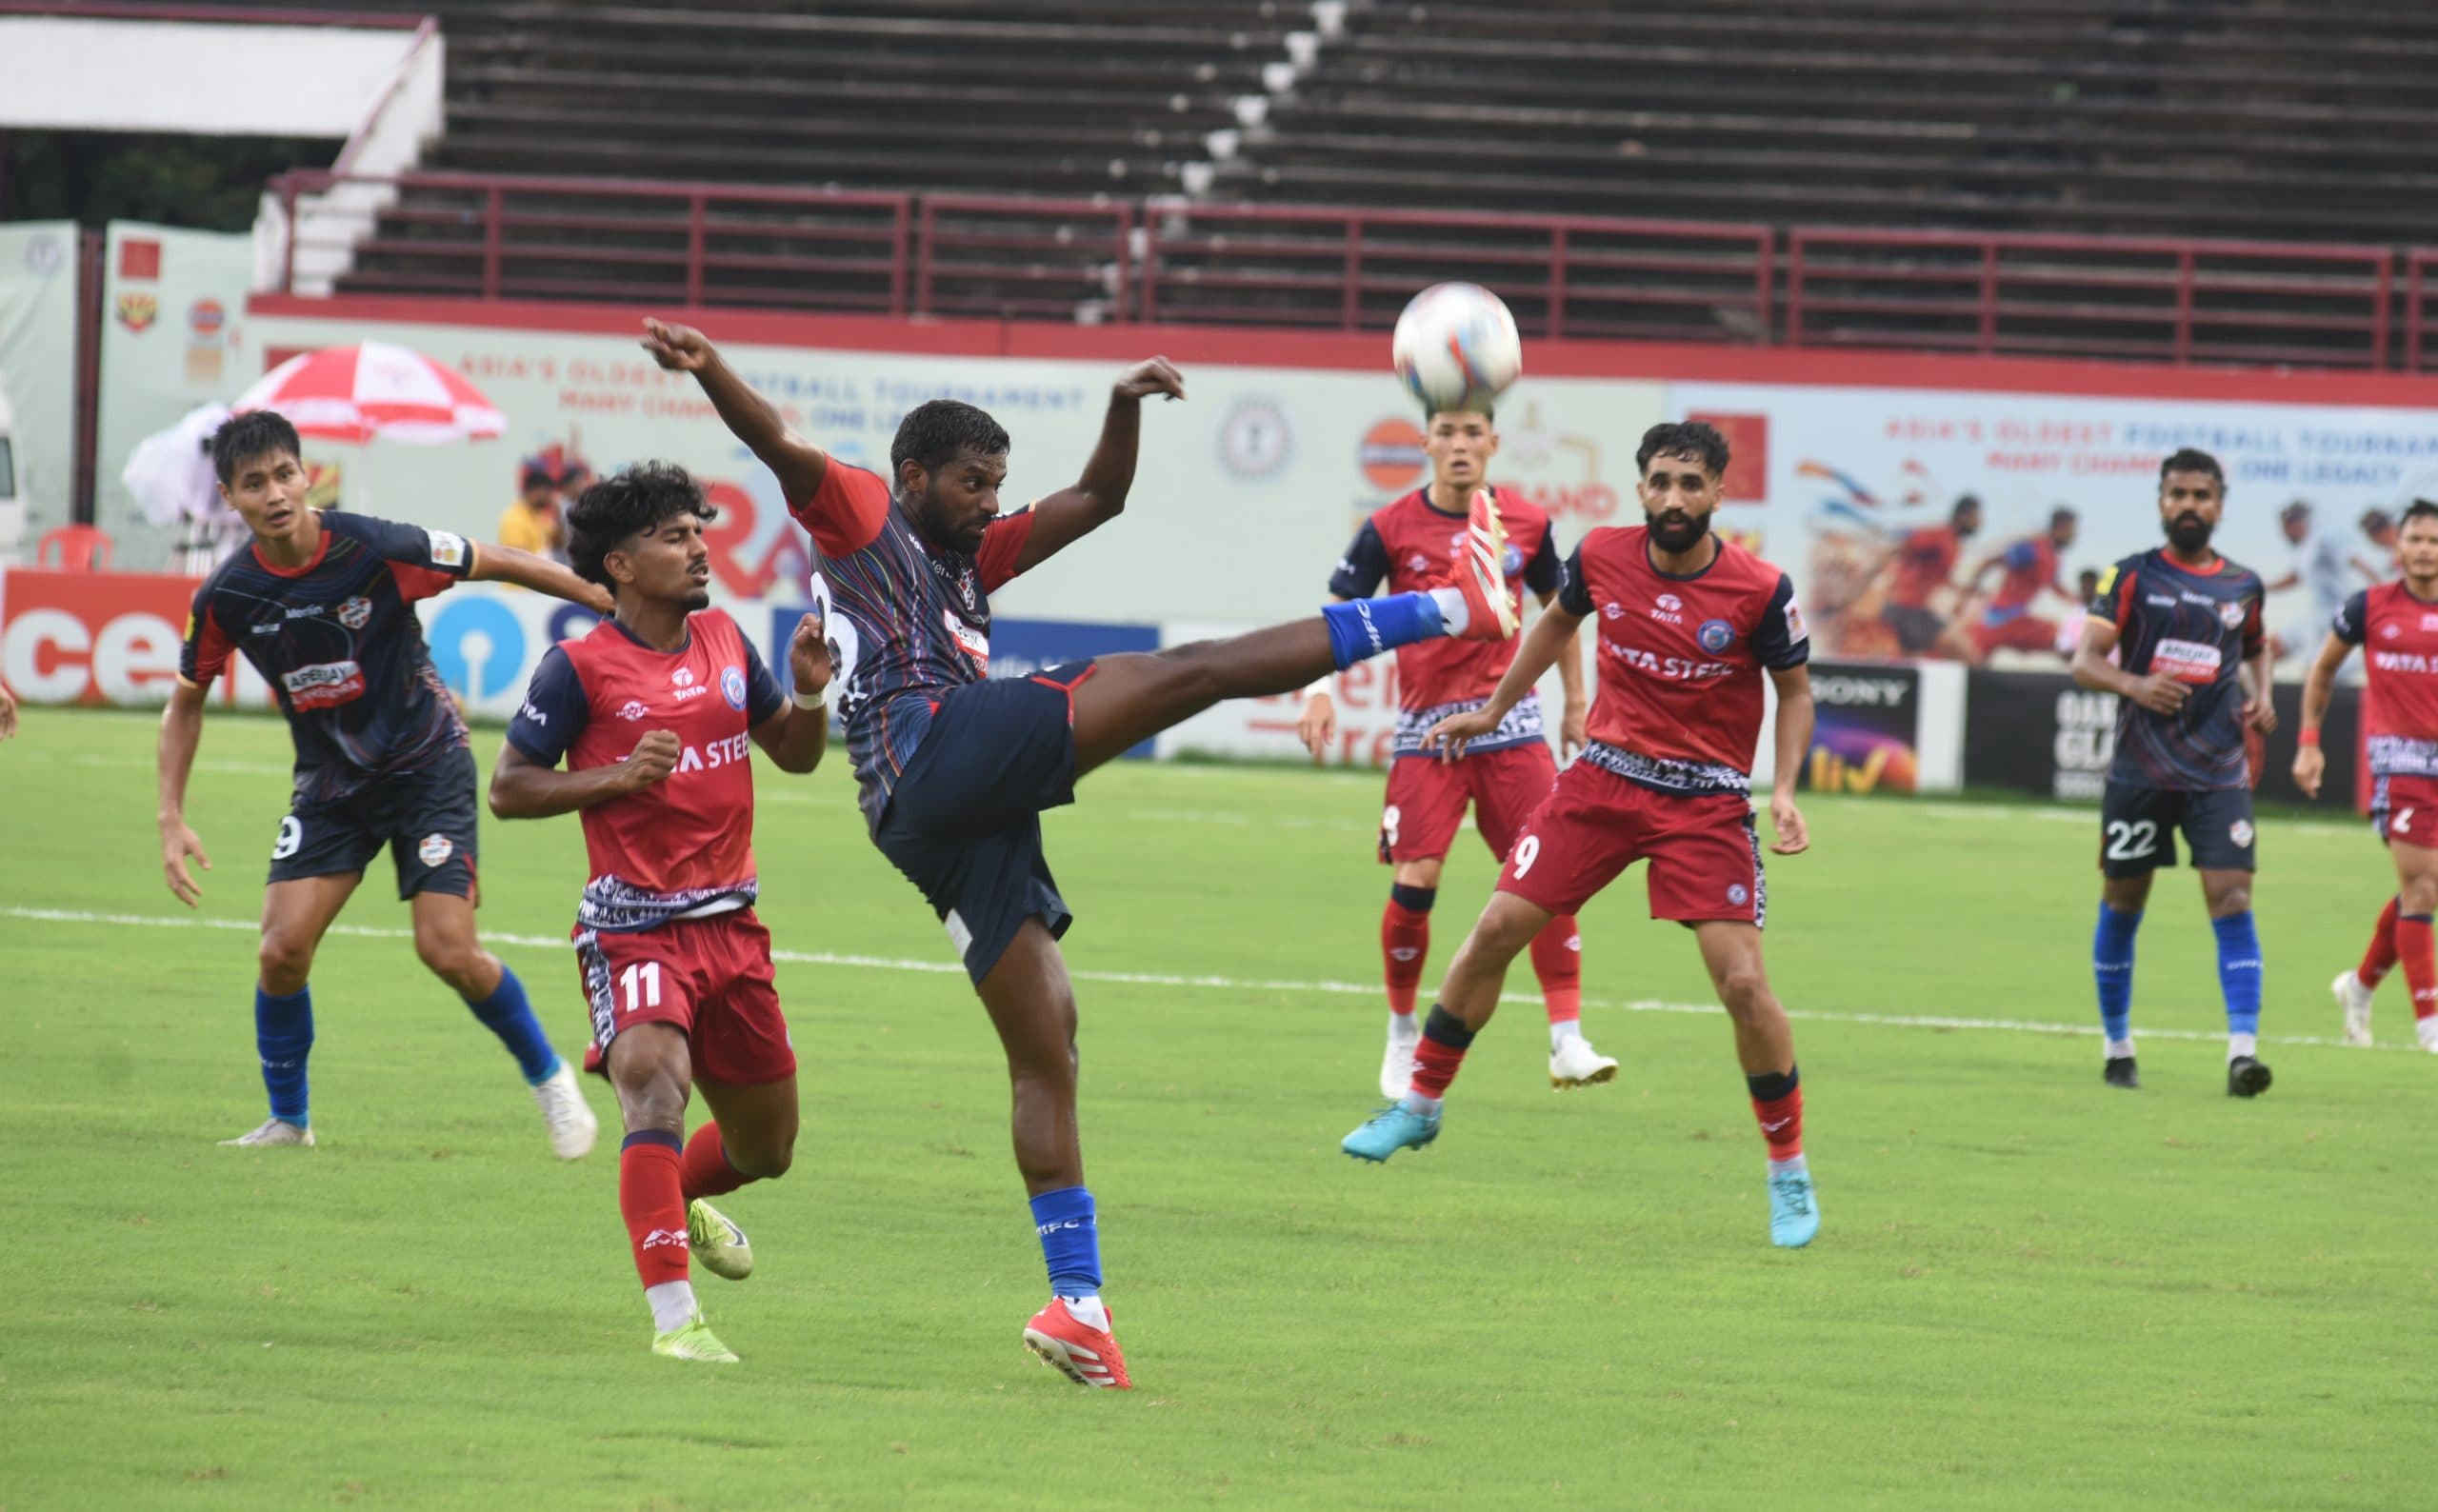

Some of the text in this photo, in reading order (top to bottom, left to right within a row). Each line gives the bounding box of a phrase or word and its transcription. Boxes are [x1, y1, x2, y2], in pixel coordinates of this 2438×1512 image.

[1512, 834, 1540, 881] 9
[2107, 820, 2157, 860] 22
[620, 961, 661, 1013] 11
